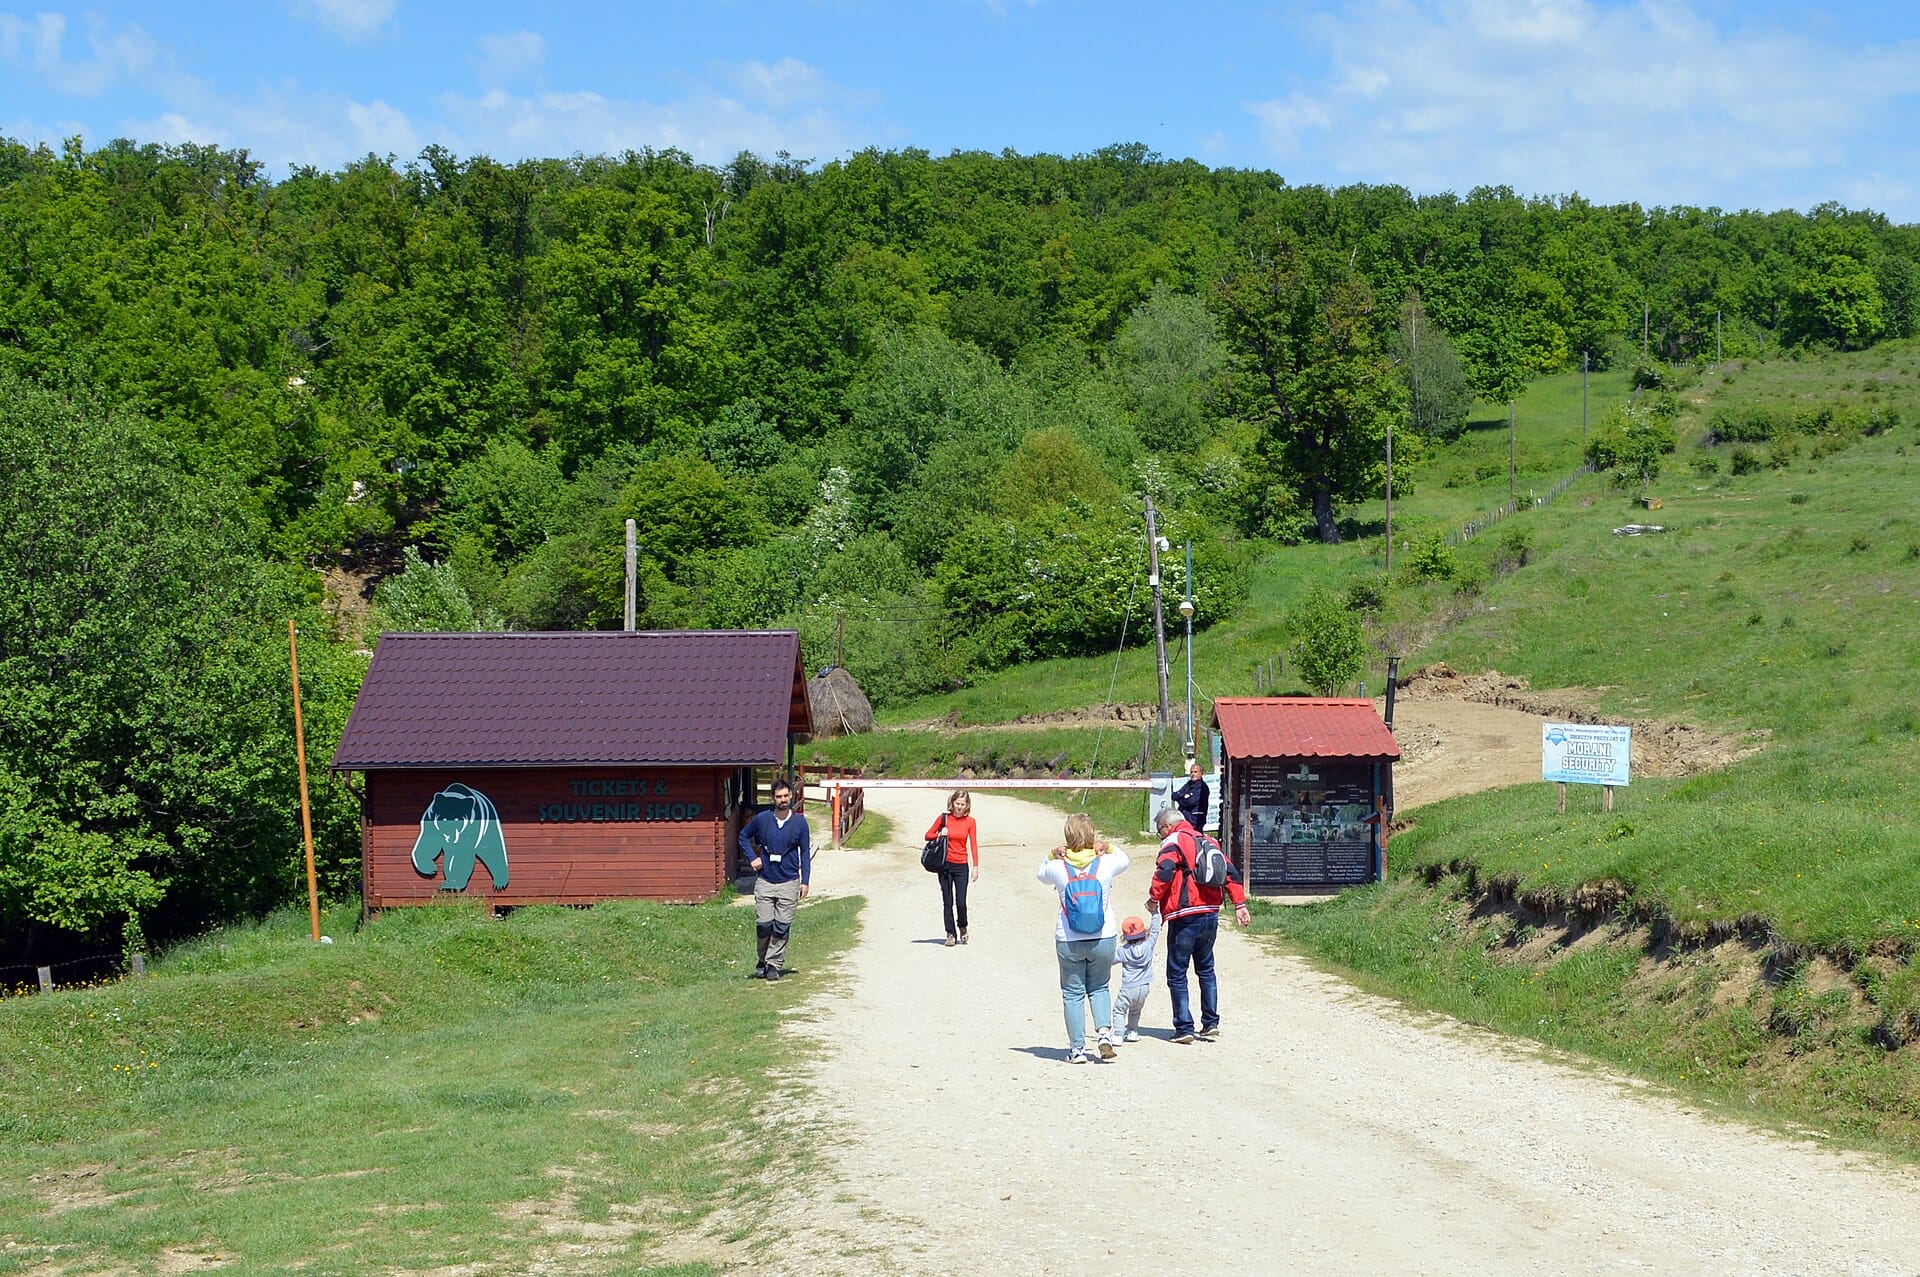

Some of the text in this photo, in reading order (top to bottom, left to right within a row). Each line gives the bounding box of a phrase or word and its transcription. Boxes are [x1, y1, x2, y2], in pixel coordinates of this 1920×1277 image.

[1567, 741, 1611, 757] MORANI
[1562, 756, 1616, 772] SECURITY
[570, 779, 668, 796] TICKETS &
[539, 803, 701, 822] SOUVENIR SHOP
